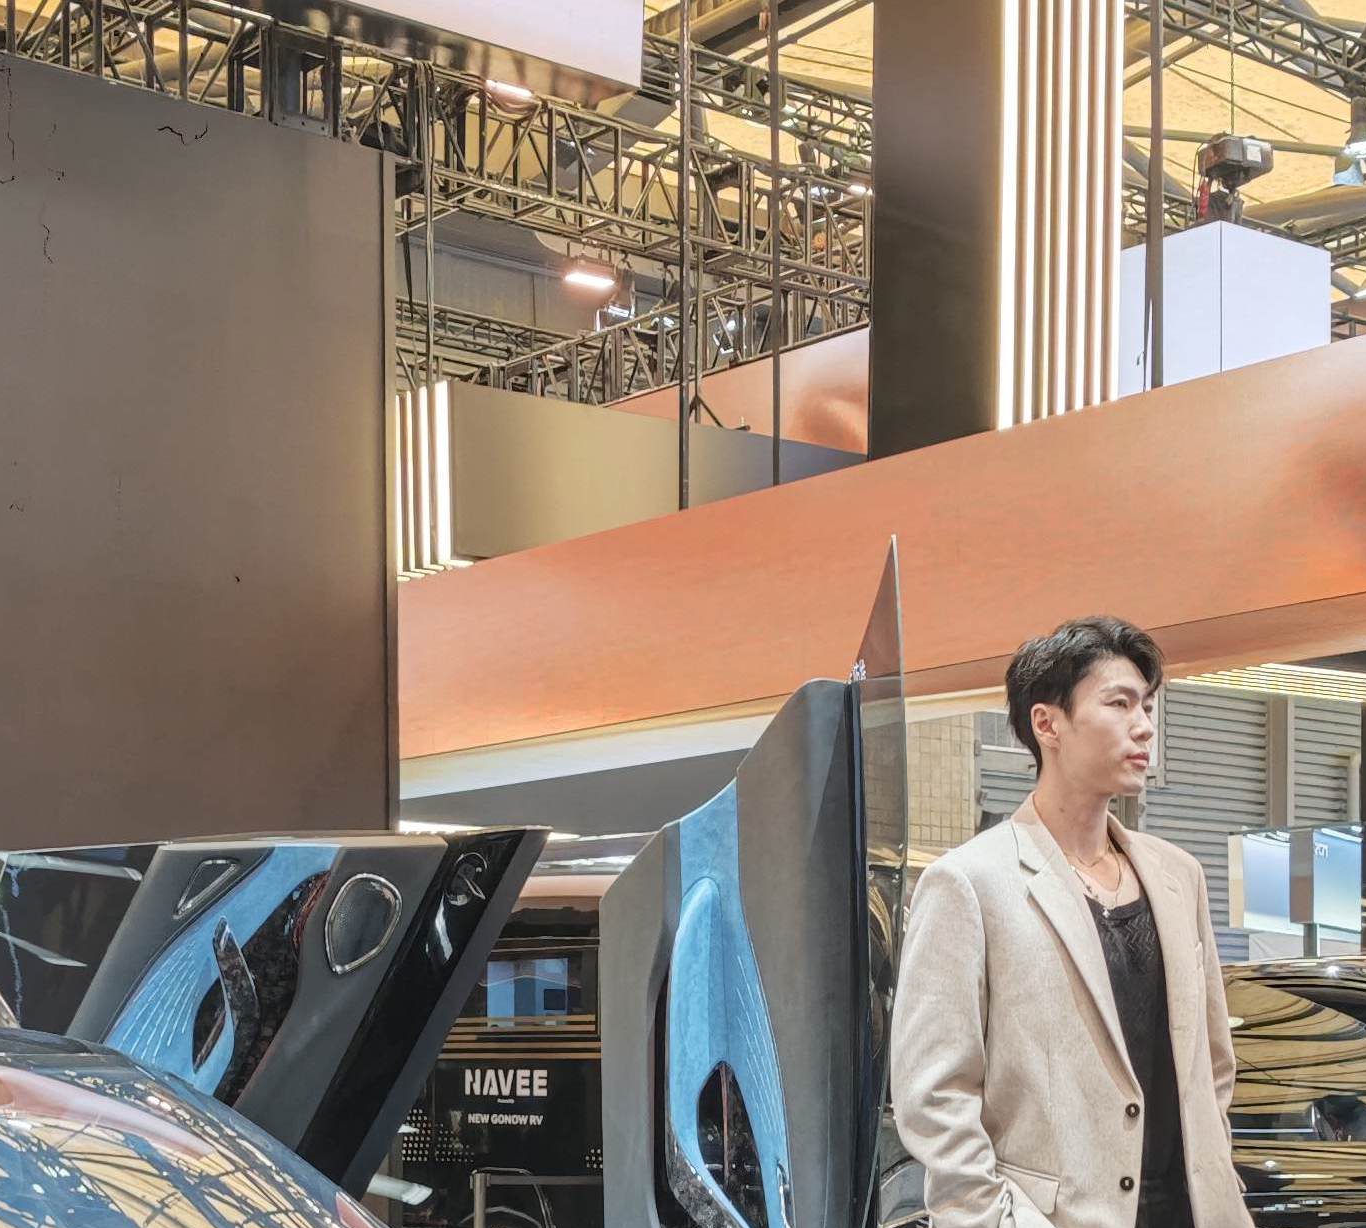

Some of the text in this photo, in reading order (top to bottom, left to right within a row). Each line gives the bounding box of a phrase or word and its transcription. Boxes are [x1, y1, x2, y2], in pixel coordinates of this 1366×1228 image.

[464, 1068, 548, 1097] NAVEE
[467, 1113, 544, 1126] NEW GONOW RV
